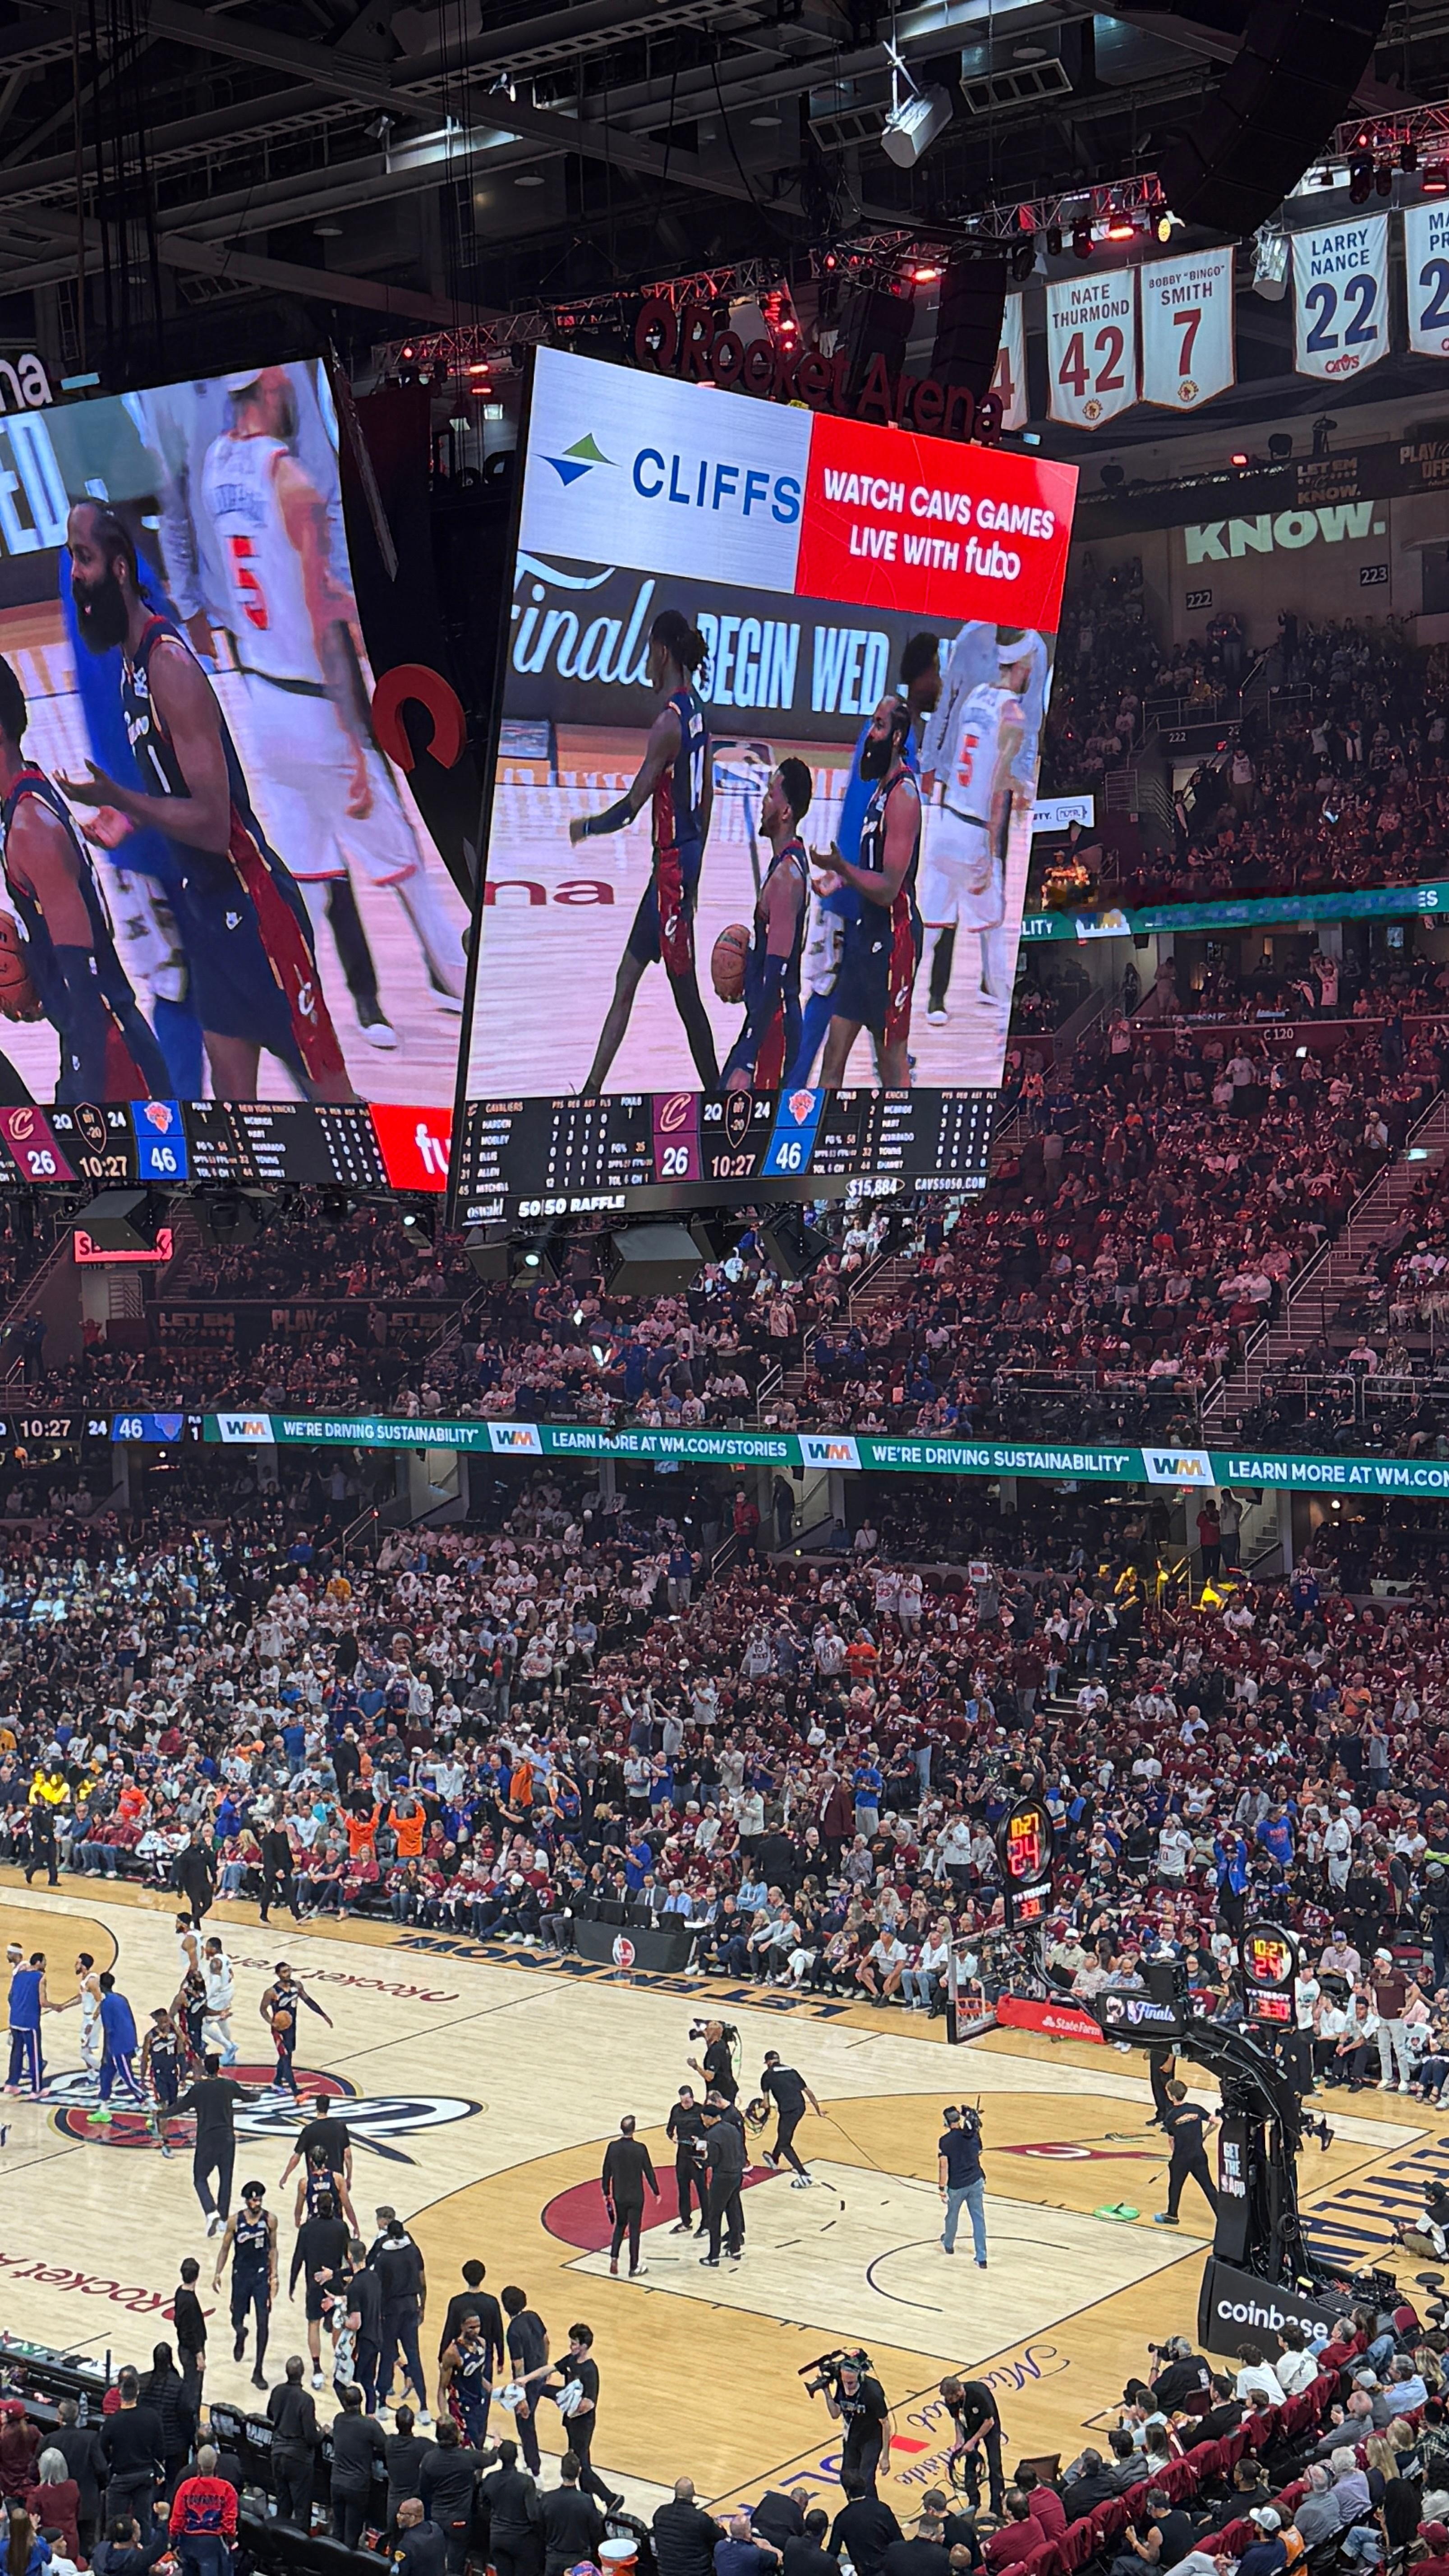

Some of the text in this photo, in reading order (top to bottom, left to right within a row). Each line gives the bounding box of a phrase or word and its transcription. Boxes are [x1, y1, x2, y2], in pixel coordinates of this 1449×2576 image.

[1312, 228, 1368, 256] LARRY
[1311, 249, 1370, 276] NANCE
[1071, 284, 1110, 305] NATE
[1149, 274, 1181, 289] BOBBY
[1161, 281, 1213, 305] SMITH
[1052, 299, 1129, 329] THURMOND
[1305, 274, 1378, 353] 22
[1173, 308, 1201, 376] 7
[1058, 326, 1124, 397] 42
[991, 347, 1015, 410] 4
[856, 353, 1003, 444] Arena
[1400, 442, 1436, 465] PLAY
[1298, 461, 1329, 476] LET
[633, 448, 802, 524] CLIFFS
[823, 468, 1056, 541] WATCH CAVS GAMES
[1185, 500, 1386, 564] KNOW.
[849, 525, 1021, 581] LIVE WITH fubo
[1362, 567, 1386, 584] 223
[1187, 593, 1211, 608] 222
[811, 626, 889, 716] WED
[1169, 732, 1186, 743] 222
[1274, 1027, 1293, 1040] 120
[107, 1112, 126, 1127] 24
[754, 1101, 770, 1118] 24
[28, 1150, 56, 1174] 26
[79, 1155, 127, 1177] 10:27
[151, 1147, 177, 1172] 46
[662, 1146, 689, 1175] 26
[711, 1154, 756, 1177] 10:27
[776, 1142, 801, 1169] 46
[570, 1195, 625, 1212] RAFFLE
[849, 1178, 897, 1198] $15,884
[159, 1313, 199, 1327] LET
[20, 1420, 71, 1438] 10:27
[88, 1421, 108, 1436] 24
[119, 1419, 143, 1439] 46
[192, 1427, 199, 1440] 1
[227, 1421, 267, 1435] WM
[284, 1421, 322, 1437] WE'RE
[325, 1422, 374, 1440] DRIVING
[496, 1431, 534, 1447] WM
[552, 1432, 595, 1449] LEARN
[599, 1435, 637, 1451] MORE
[639, 1435, 658, 1452] AT
[659, 1436, 787, 1457] WM.COM/STORIES
[808, 1442, 852, 1461] WM
[873, 1445, 921, 1464] WE'RE
[925, 1447, 990, 1466] DRIVING
[1153, 1457, 1205, 1476] WM
[1229, 1460, 1288, 1481] LEARN
[1291, 1463, 1345, 1483] MORE
[1349, 1466, 1372, 1484] AT
[1011, 1812, 1039, 1839] 10:27
[1007, 1833, 1039, 1875] 24
[1254, 1940, 1286, 1959] 10:27
[1256, 1957, 1283, 1980] 24
[9, 2263, 175, 2314] Rocket
